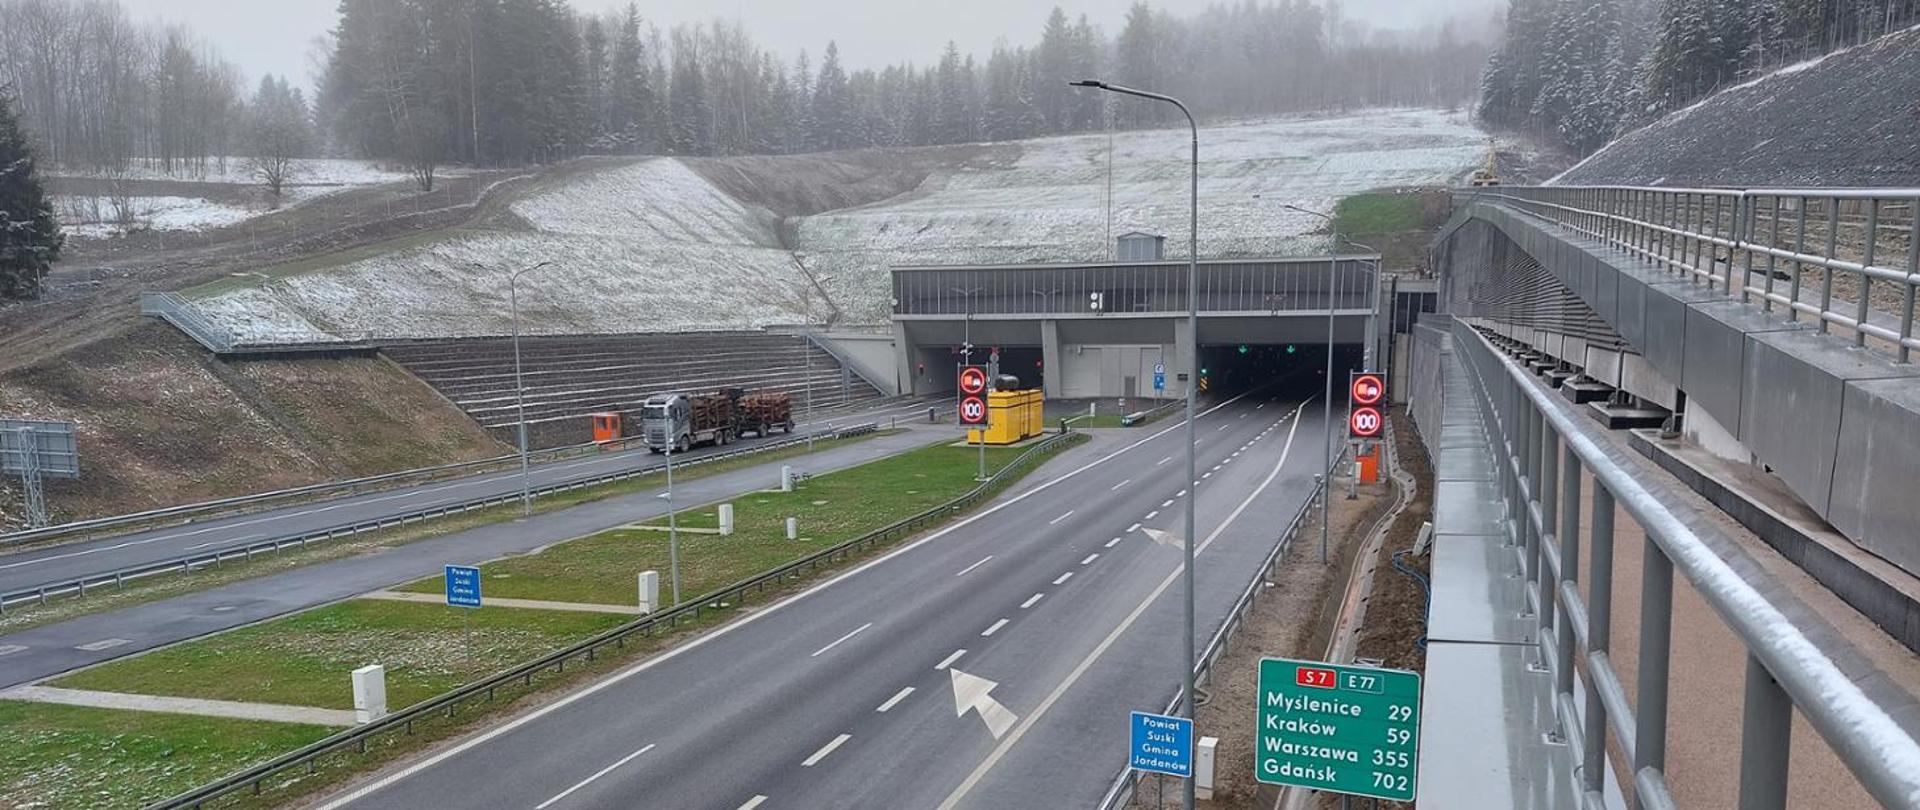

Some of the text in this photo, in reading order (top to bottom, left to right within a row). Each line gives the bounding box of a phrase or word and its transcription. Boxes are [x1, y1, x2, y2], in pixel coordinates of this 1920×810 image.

[964, 403, 981, 417] 100
[1356, 414, 1376, 429] 100
[1306, 671, 1328, 684] S 7
[1348, 675, 1376, 689] E 77
[1267, 691, 1412, 722] Myślenice 29
[1143, 716, 1180, 731] Powiat
[1266, 714, 1411, 745] Kraków 59
[1142, 743, 1179, 757] Gmina
[1264, 736, 1409, 768] Warszawa 355
[1263, 758, 1408, 791] Gdańsk 702
